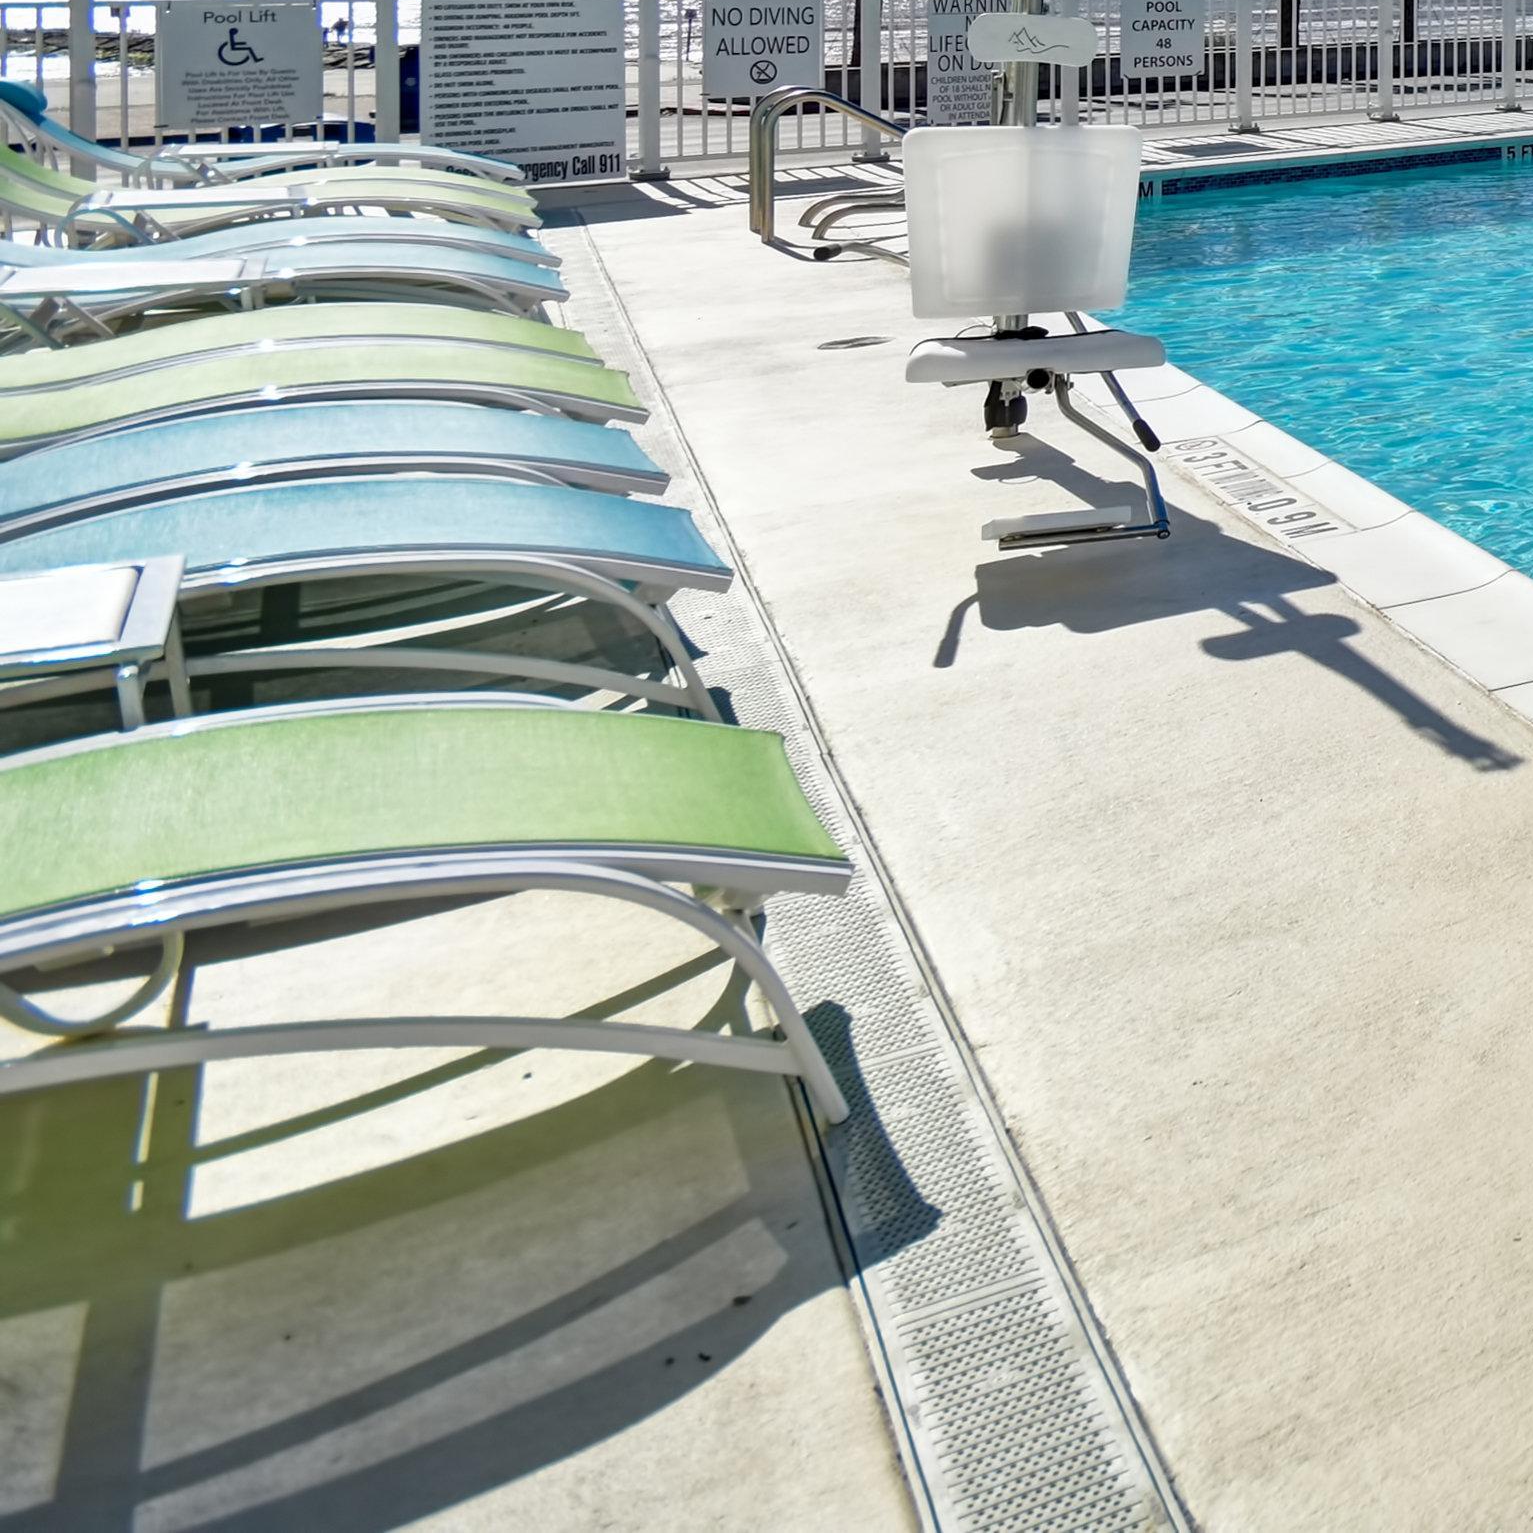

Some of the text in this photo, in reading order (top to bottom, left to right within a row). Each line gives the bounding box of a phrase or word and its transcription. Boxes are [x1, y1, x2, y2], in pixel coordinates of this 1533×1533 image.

[1146, 1, 1182, 13] POOL
[203, 10, 277, 24] Pool Lift
[712, 6, 814, 26] NO DIVING
[1132, 19, 1195, 32] CAPACITY
[716, 36, 810, 56] ALLOWED
[930, 35, 969, 52] LIFE
[1156, 38, 1172, 49] 48
[938, 54, 994, 72] ON DU
[1134, 55, 1193, 68] PERSONS
[931, 75, 966, 84] CHILDREN
[940, 85, 949, 93] OF
[952, 84, 960, 92] 18
[961, 84, 983, 92] SHALL
[932, 93, 987, 103] POOL WITHOUT
[941, 104, 951, 112] OR
[952, 102, 975, 111] ADULT
[958, 111, 990, 120] ATTENDA
[1507, 146, 1516, 159] 5
[506, 160, 568, 181] ergency
[572, 154, 595, 176] Call
[599, 153, 621, 173] 911
[1139, 181, 1153, 197] M
[1183, 452, 1228, 463] 3
[1194, 459, 1248, 477] FT
[1280, 522, 1338, 539] M
